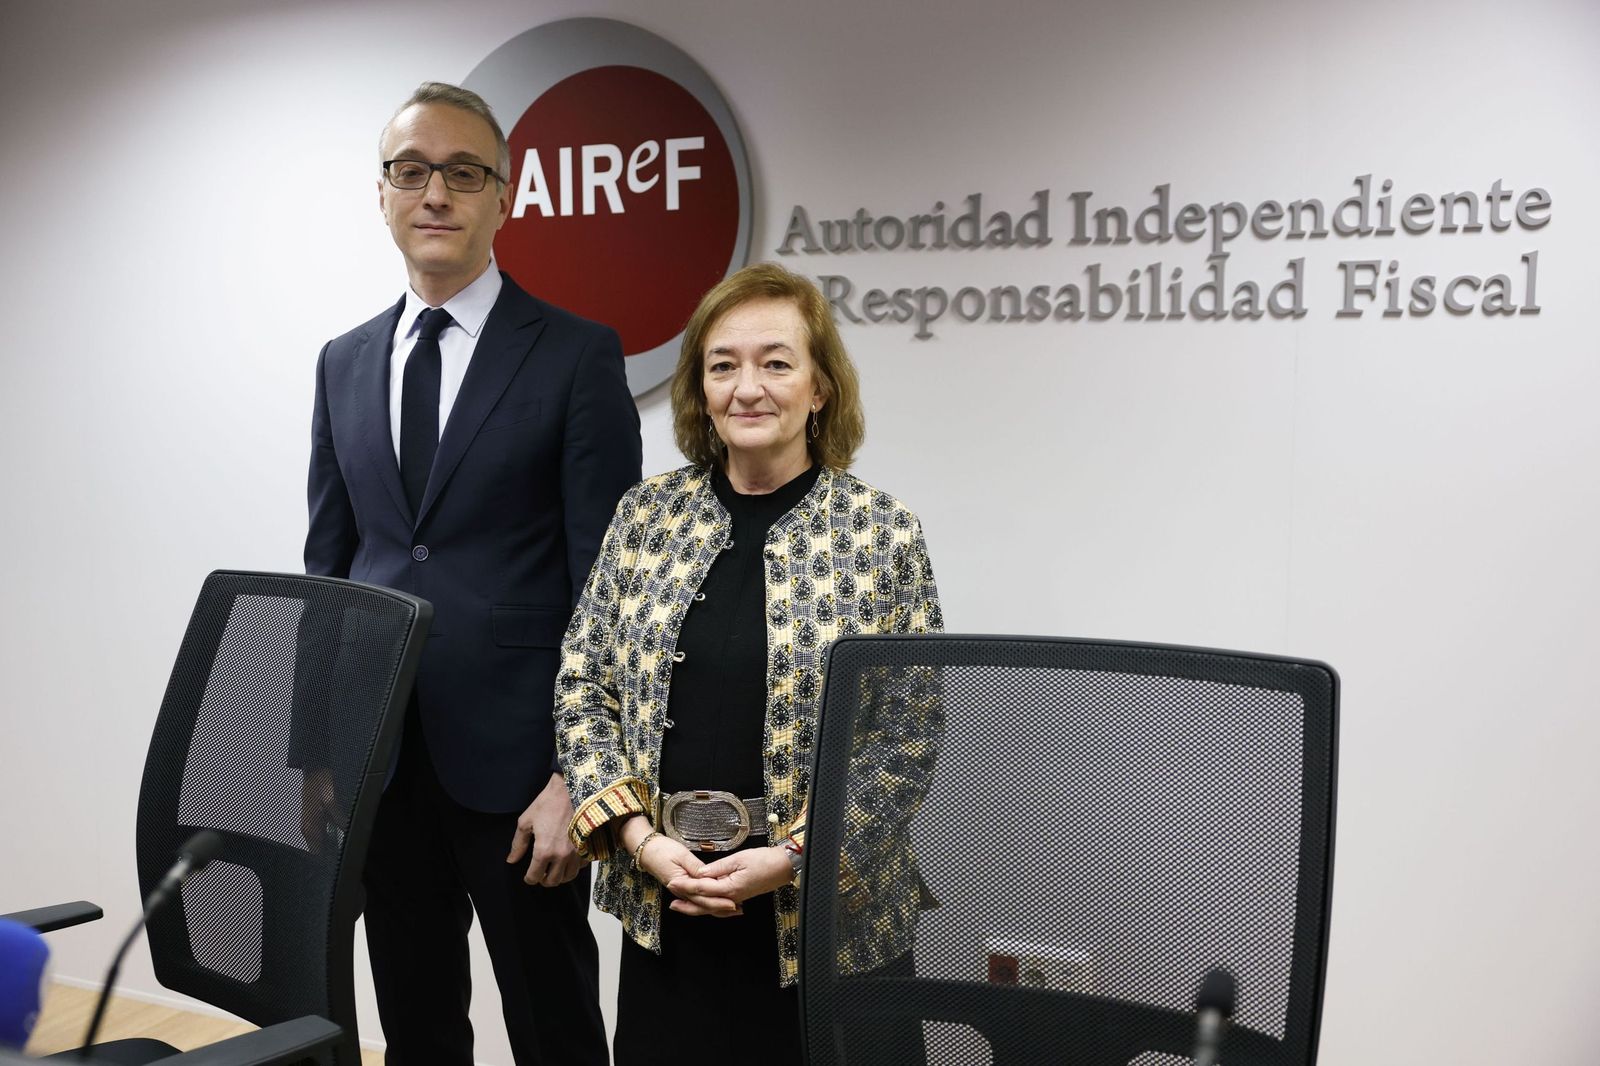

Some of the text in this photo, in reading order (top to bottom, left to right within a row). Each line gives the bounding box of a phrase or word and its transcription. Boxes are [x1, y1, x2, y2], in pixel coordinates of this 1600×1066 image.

[511, 136, 705, 219] AIReF
[776, 174, 1552, 260] Autoridad Independiente
[817, 250, 1541, 340] Responsabilidad Fiscal
